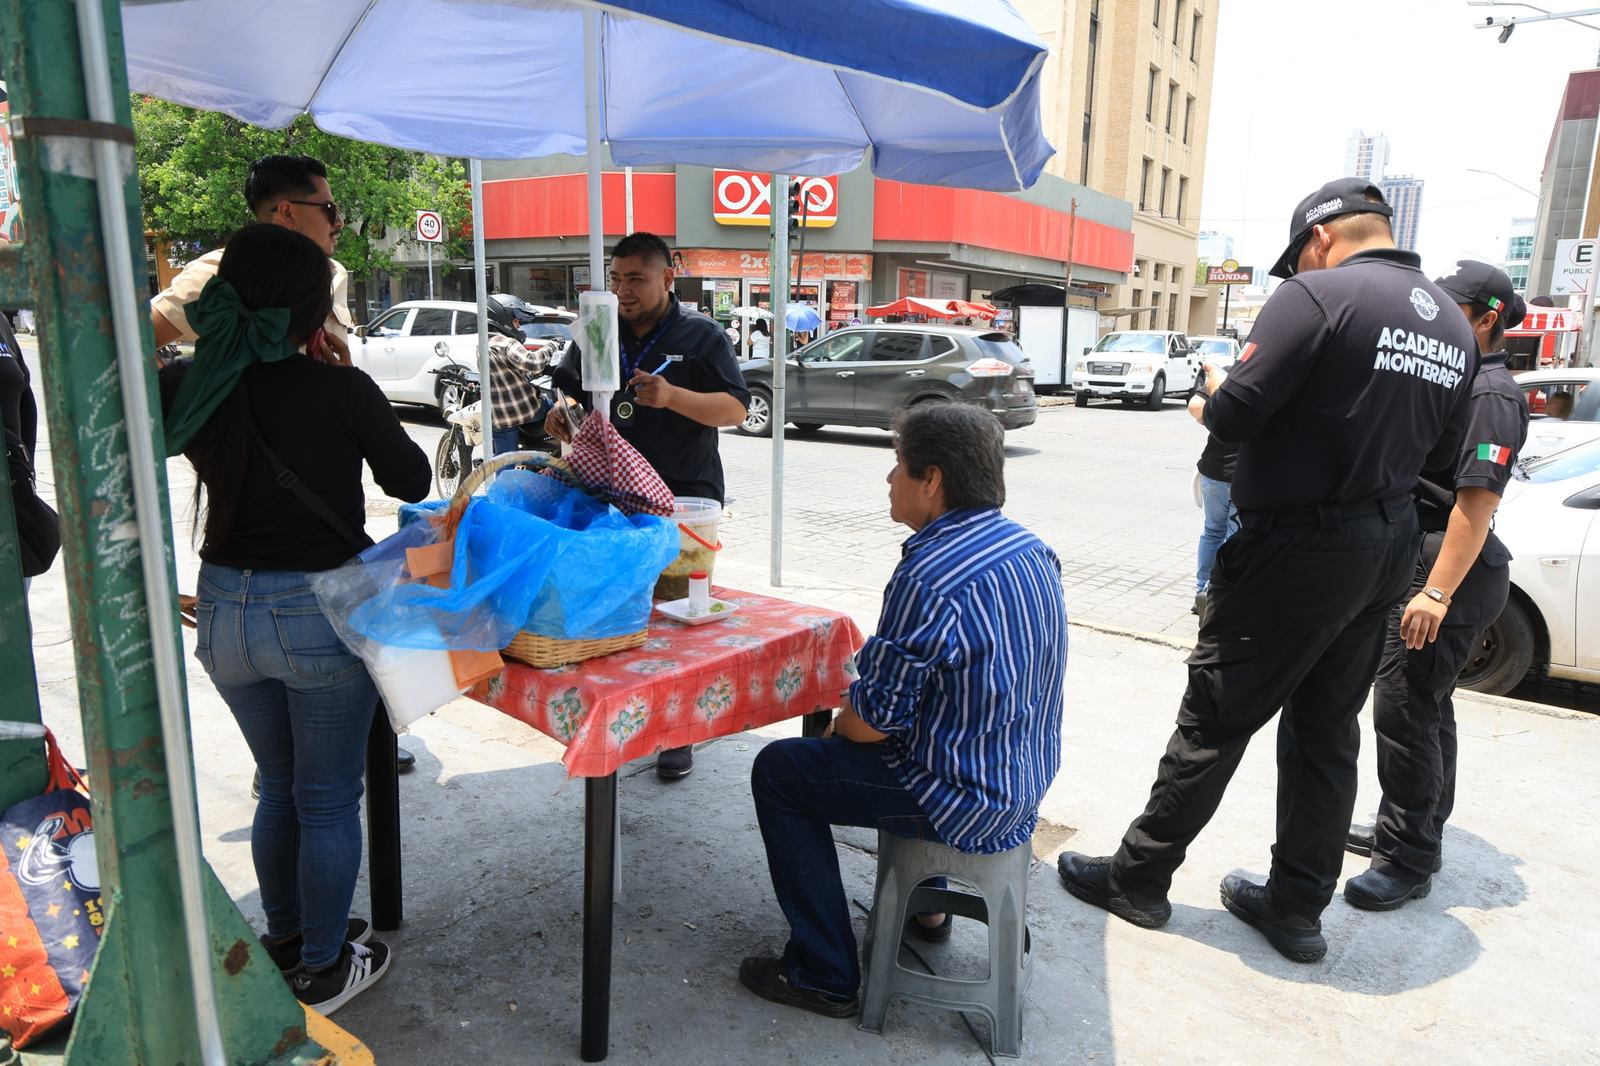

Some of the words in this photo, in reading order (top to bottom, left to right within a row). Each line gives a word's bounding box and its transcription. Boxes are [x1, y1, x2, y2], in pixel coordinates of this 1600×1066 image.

[717, 174, 834, 215] OXO
[1305, 198, 1342, 219] ACADEMIA
[1306, 204, 1343, 224] MONTERREY
[424, 219, 435, 229] 40
[1576, 245, 1593, 262] E
[1376, 327, 1466, 373] ACADEMIA
[1373, 351, 1463, 391] MONTERREY
